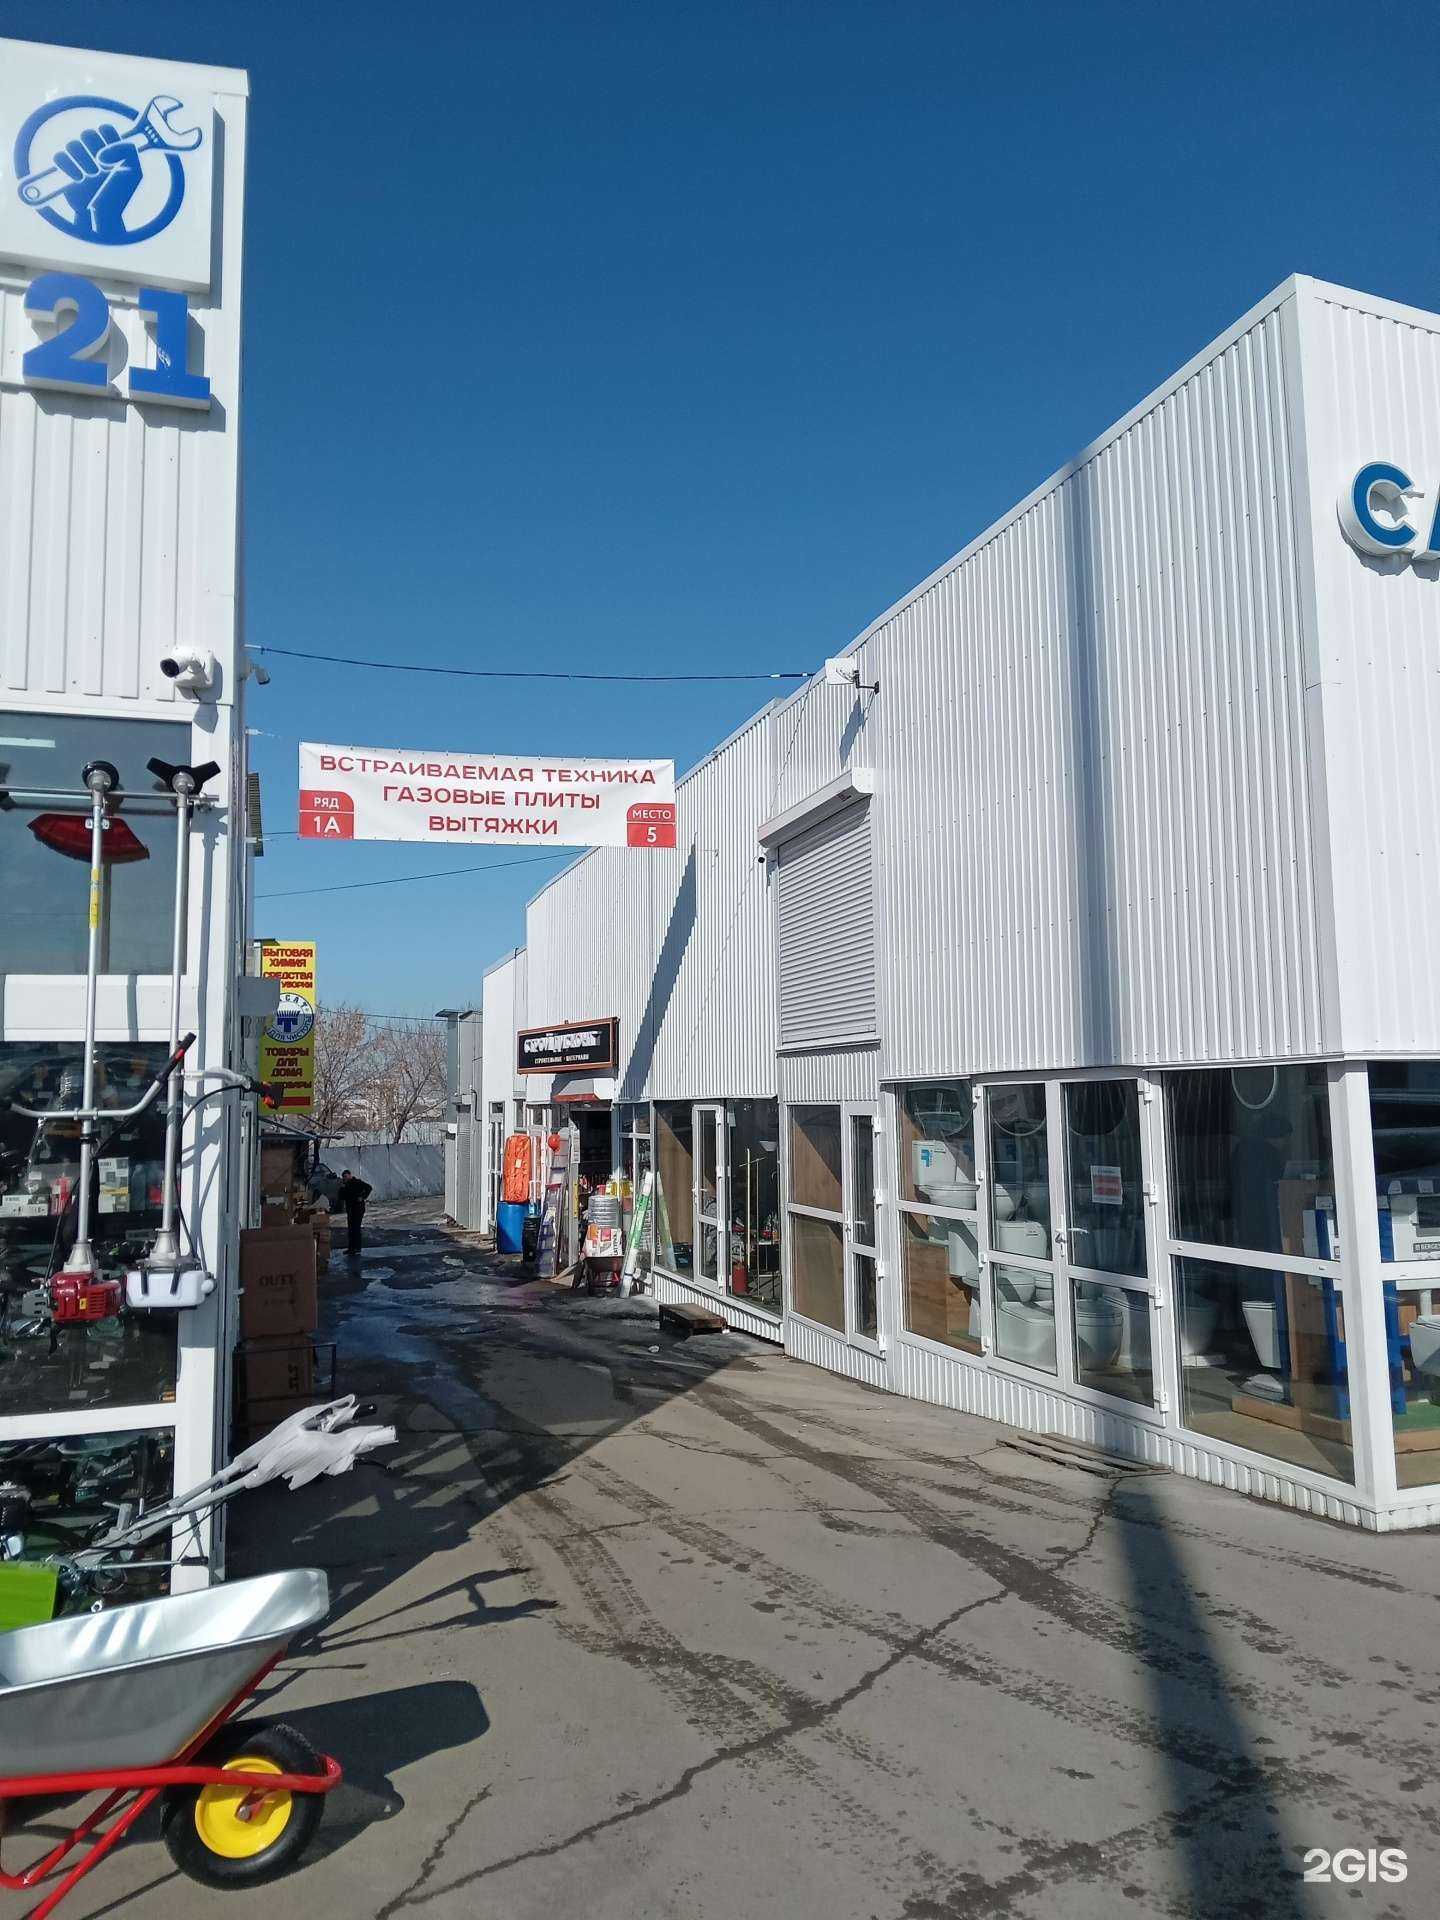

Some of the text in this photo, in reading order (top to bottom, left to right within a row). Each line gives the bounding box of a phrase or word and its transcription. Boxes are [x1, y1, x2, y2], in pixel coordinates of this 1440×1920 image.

[22, 270, 211, 402] 21
[1351, 461, 1440, 552] С
[319, 755, 656, 784] ВСТРАИВАЕМАЯ ТЕХНИКА
[313, 797, 340, 812] РЯД
[382, 786, 600, 810] ГАЗОВЫЕ ПЛИТЫ
[632, 808, 672, 821] МЕСТО
[313, 815, 342, 836] 1А
[428, 815, 559, 836] ВЫТЯЖКИ
[645, 828, 657, 844] 5
[262, 947, 314, 958] БЫТОВАЯ
[269, 958, 307, 968] ХИМИЯ
[264, 1047, 310, 1057] ТОВАРЫ
[275, 1057, 298, 1067] ДЛЯ
[270, 1067, 303, 1077] ДОМА
